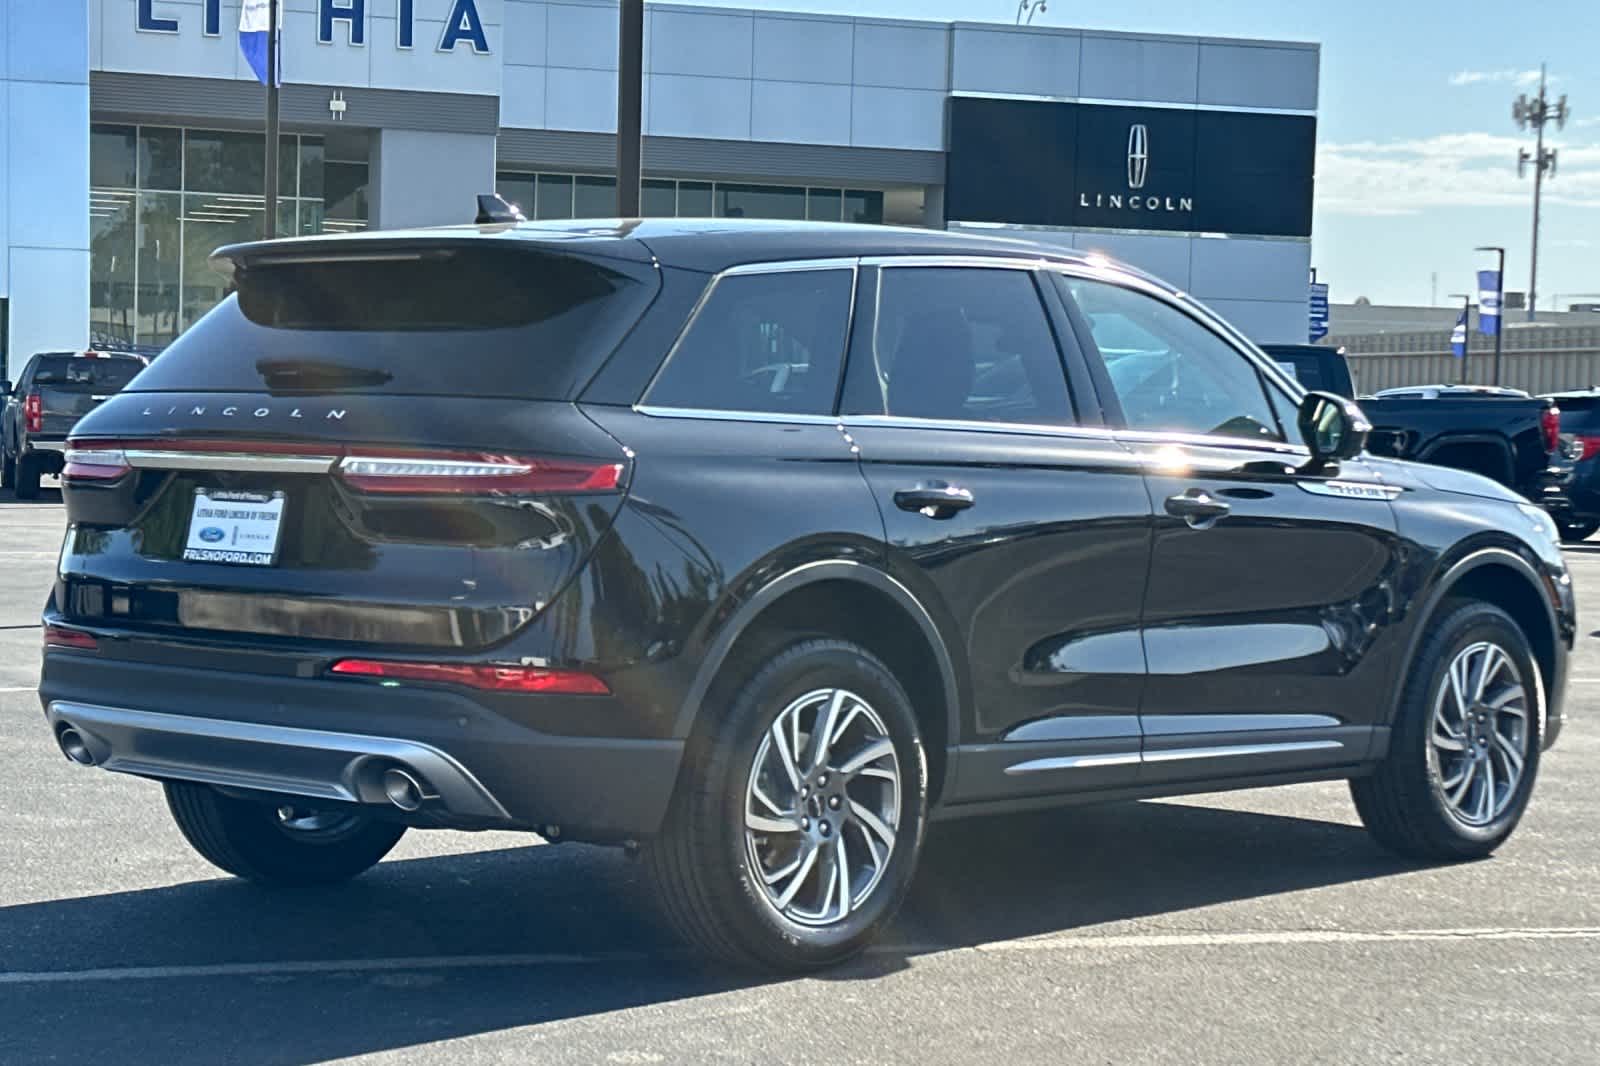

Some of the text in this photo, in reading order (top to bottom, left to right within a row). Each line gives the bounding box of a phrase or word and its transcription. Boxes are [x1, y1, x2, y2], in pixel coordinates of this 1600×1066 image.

[136, 0, 491, 54] LIHIA
[1080, 193, 1193, 211] LINCOLN
[143, 406, 346, 419] LINCOLN
